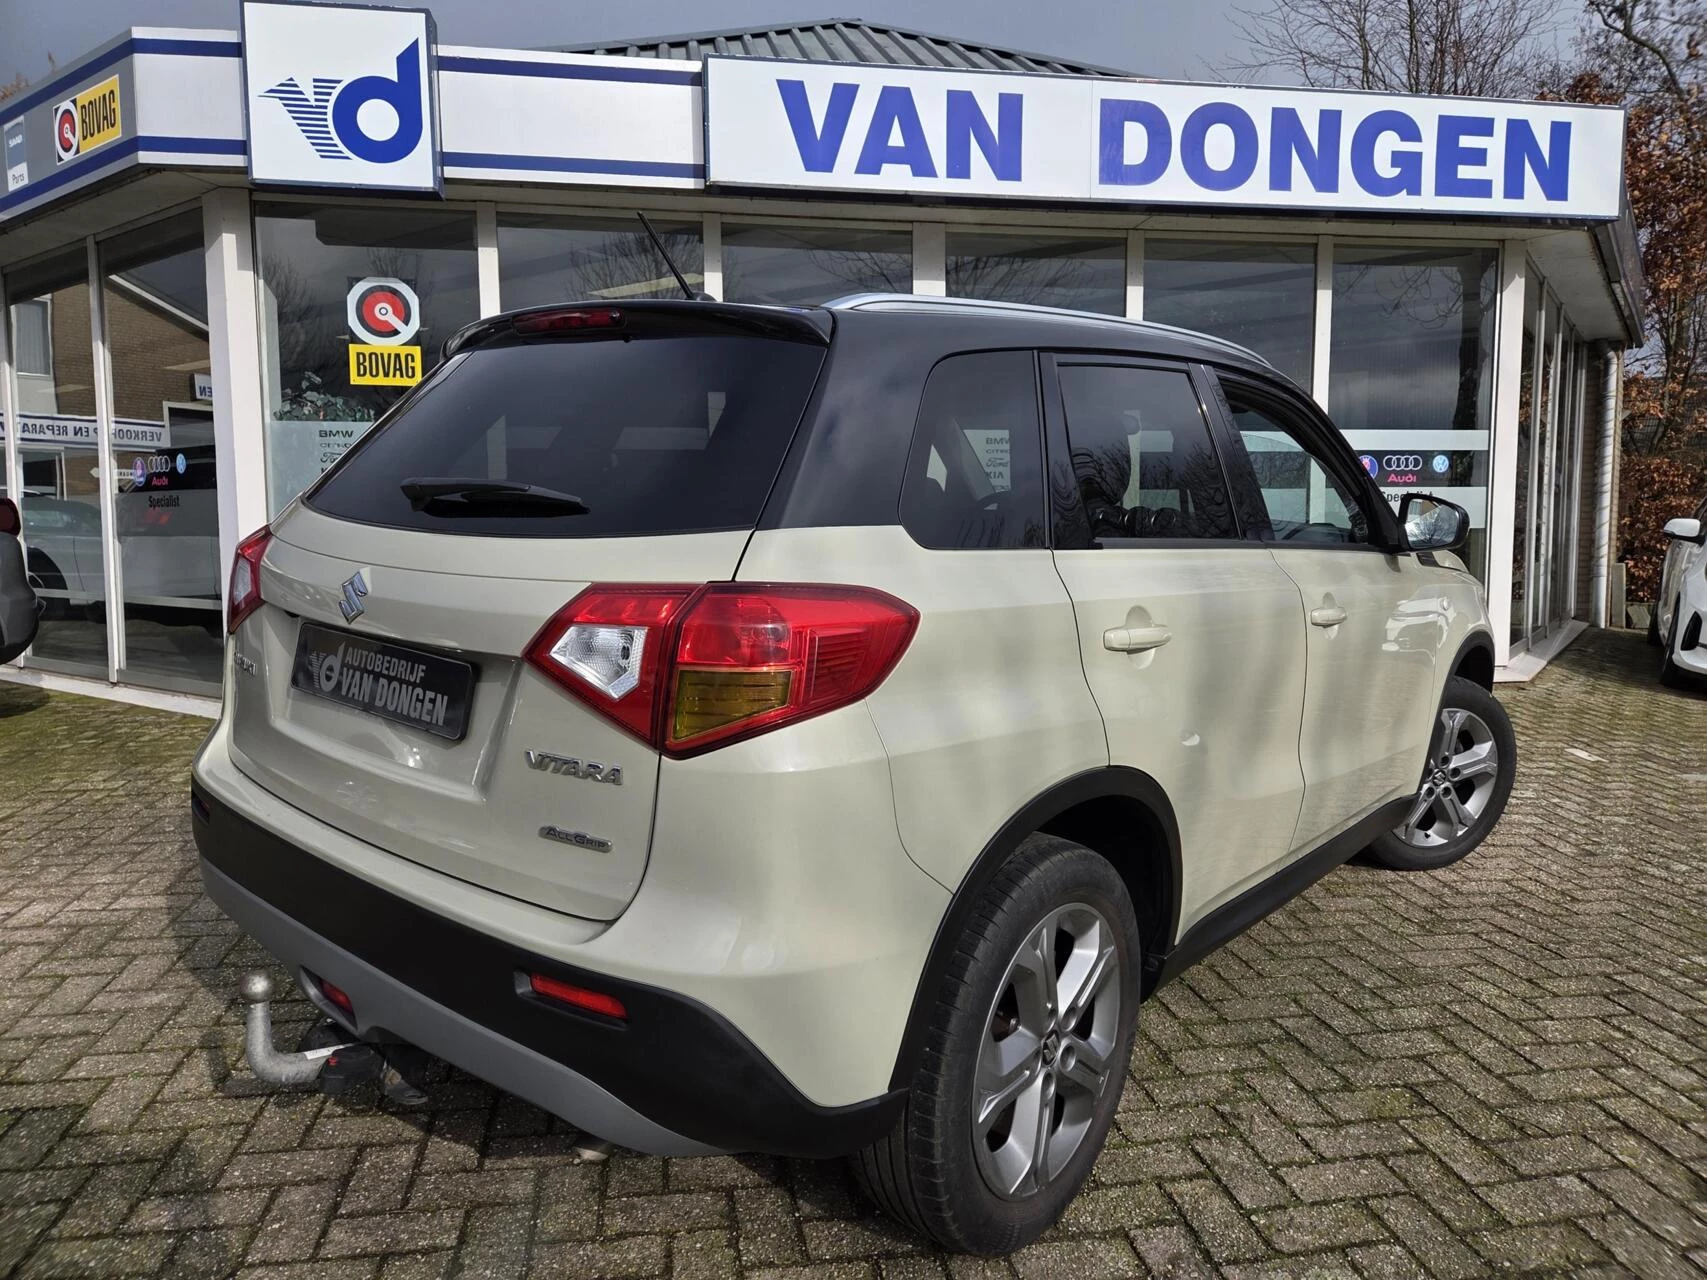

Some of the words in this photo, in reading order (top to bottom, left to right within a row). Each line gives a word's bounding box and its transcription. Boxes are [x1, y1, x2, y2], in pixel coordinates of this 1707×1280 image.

[80, 89, 117, 141] BOVAG
[776, 79, 1024, 182] VAN
[1099, 97, 1572, 202] DONGEN
[356, 351, 416, 379] BOVAG
[319, 430, 354, 438] BMW
[152, 477, 169, 486] Audi
[1387, 473, 1417, 482] Audi
[148, 496, 180, 508] Specialist
[345, 647, 426, 684] AUTOBEDRIJF
[341, 668, 373, 703] VAN
[374, 678, 448, 726] DONGEN
[525, 748, 624, 785] VITARA
